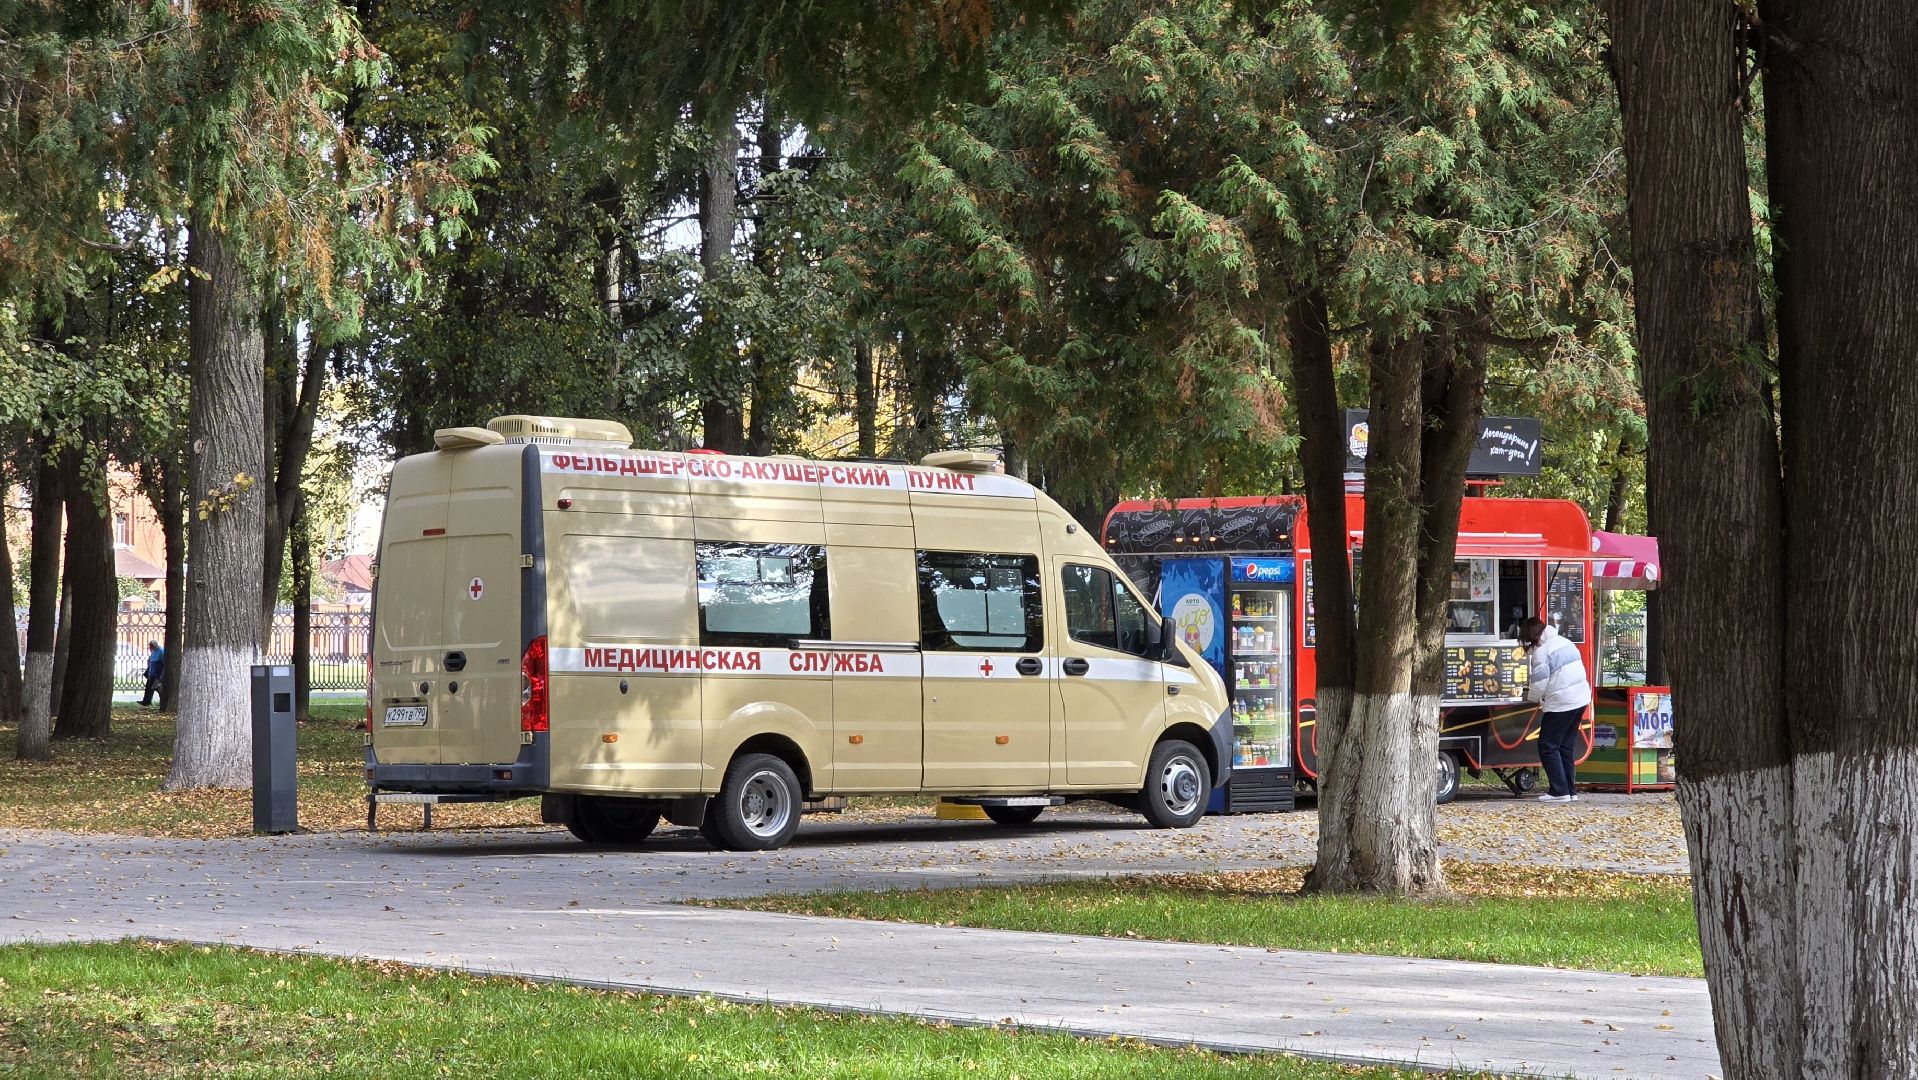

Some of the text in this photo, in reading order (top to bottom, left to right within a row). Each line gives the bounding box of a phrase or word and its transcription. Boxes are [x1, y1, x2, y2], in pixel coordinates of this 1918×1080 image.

[552, 452, 976, 491] ФЕЛЬДШЕРСКО-АКУШЕРСКИЙ ПУНКТ
[1258, 564, 1281, 579] pepsi
[585, 648, 884, 673] МЕДИЦИНСКАЯ СЛУЖБА
